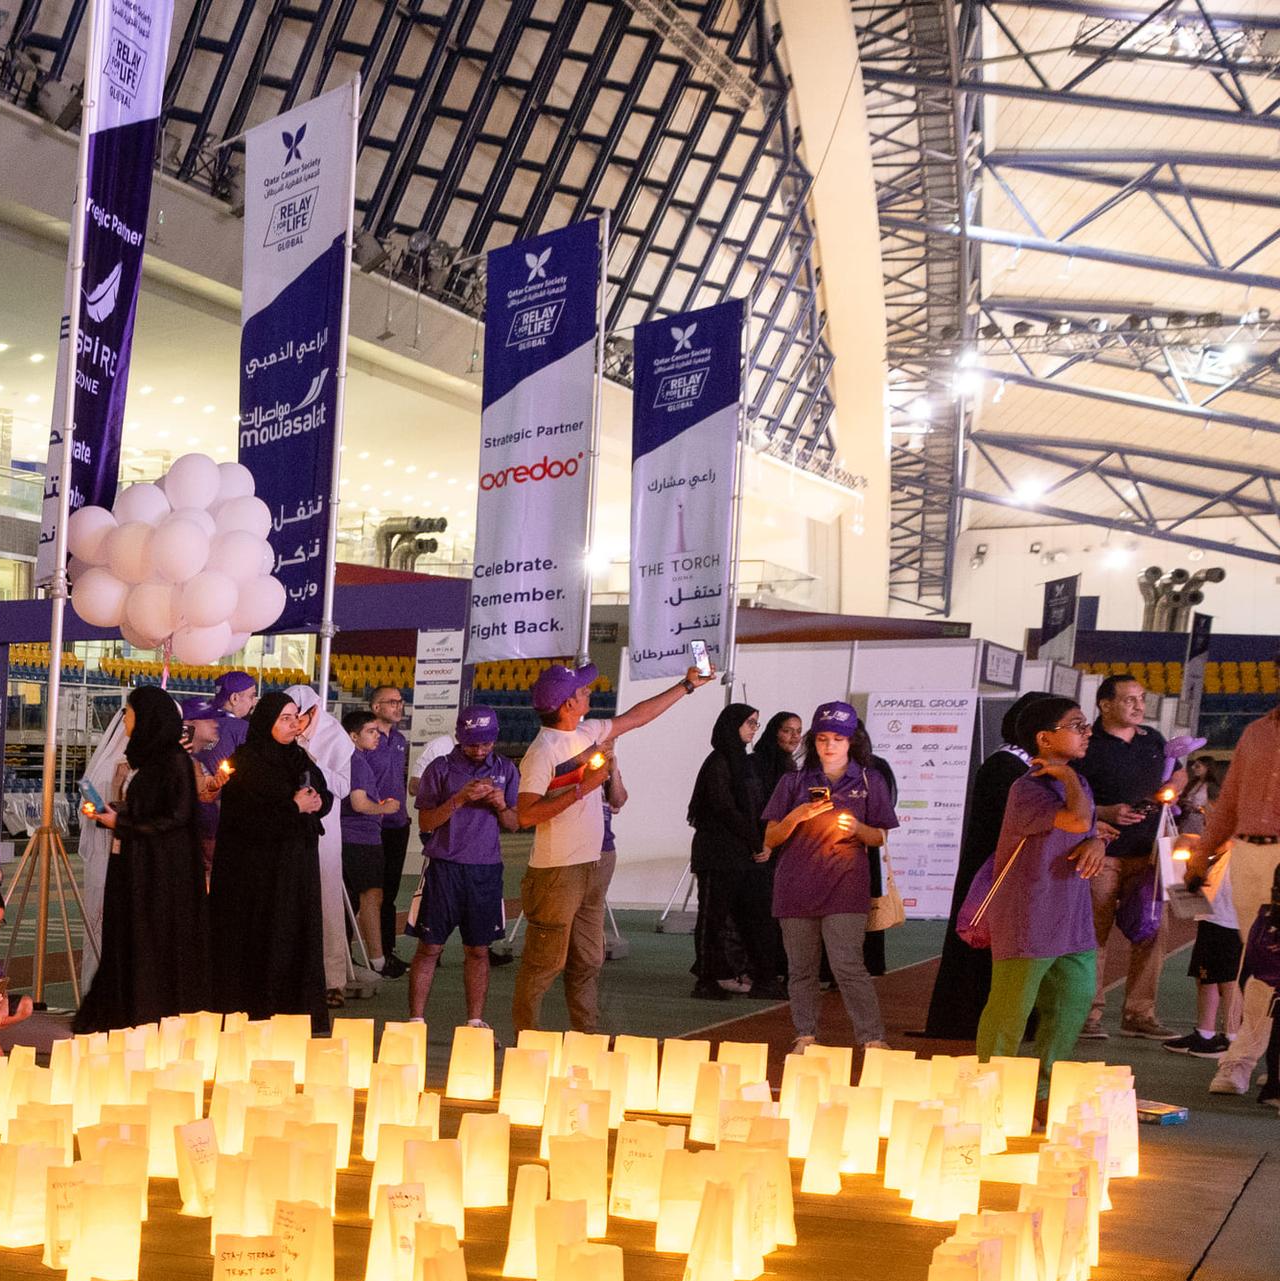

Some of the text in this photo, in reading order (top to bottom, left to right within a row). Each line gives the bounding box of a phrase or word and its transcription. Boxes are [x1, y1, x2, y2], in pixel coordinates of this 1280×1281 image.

[115, 40, 141, 69] RELAY
[118, 65, 138, 90] LIFE
[280, 195, 312, 219] RELAY
[111, 214, 143, 247] Partner
[287, 213, 308, 233] LIFE
[522, 305, 557, 325] RELAY
[528, 320, 551, 336] LIFE
[245, 327, 328, 379] الراعي الذهبي
[670, 372, 703, 390] RELAY
[677, 384, 698, 399] LIFE
[240, 402, 327, 449] mowasalat
[241, 401, 290, 430] مواصلات
[483, 421, 584, 449] Strategic Partner
[480, 452, 583, 491] ooredoo
[647, 469, 716, 494] راعي مشارك
[473, 557, 558, 579] Celebrate.
[638, 554, 720, 579] THE TORCH
[471, 587, 566, 609] Remember.
[664, 583, 723, 607] نحتفل.
[470, 618, 564, 641] Fight Back.
[670, 612, 721, 636] نتذكر.
[875, 699, 968, 708] APPAREL GROUP
